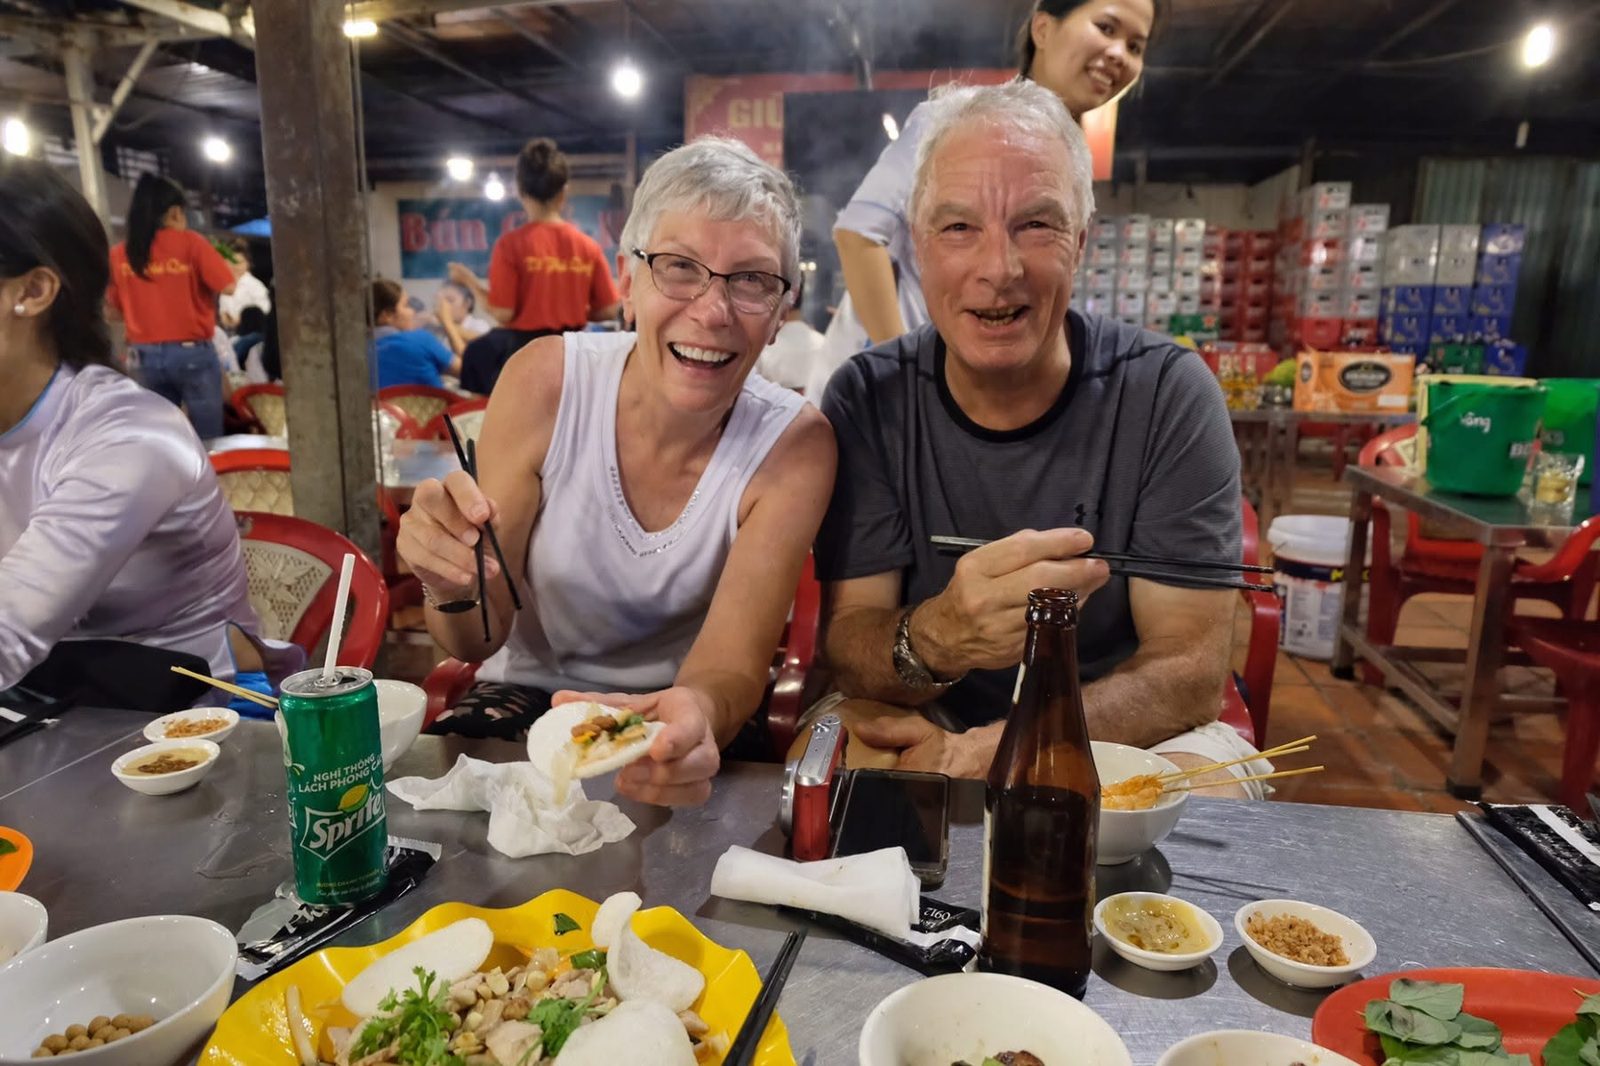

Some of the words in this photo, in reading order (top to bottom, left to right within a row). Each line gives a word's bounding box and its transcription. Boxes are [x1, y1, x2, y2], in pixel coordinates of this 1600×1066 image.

[298, 781, 327, 793] LÁCH
[330, 767, 369, 789] PHONG
[309, 791, 381, 851] Sprite
[923, 907, 951, 921] 0912
